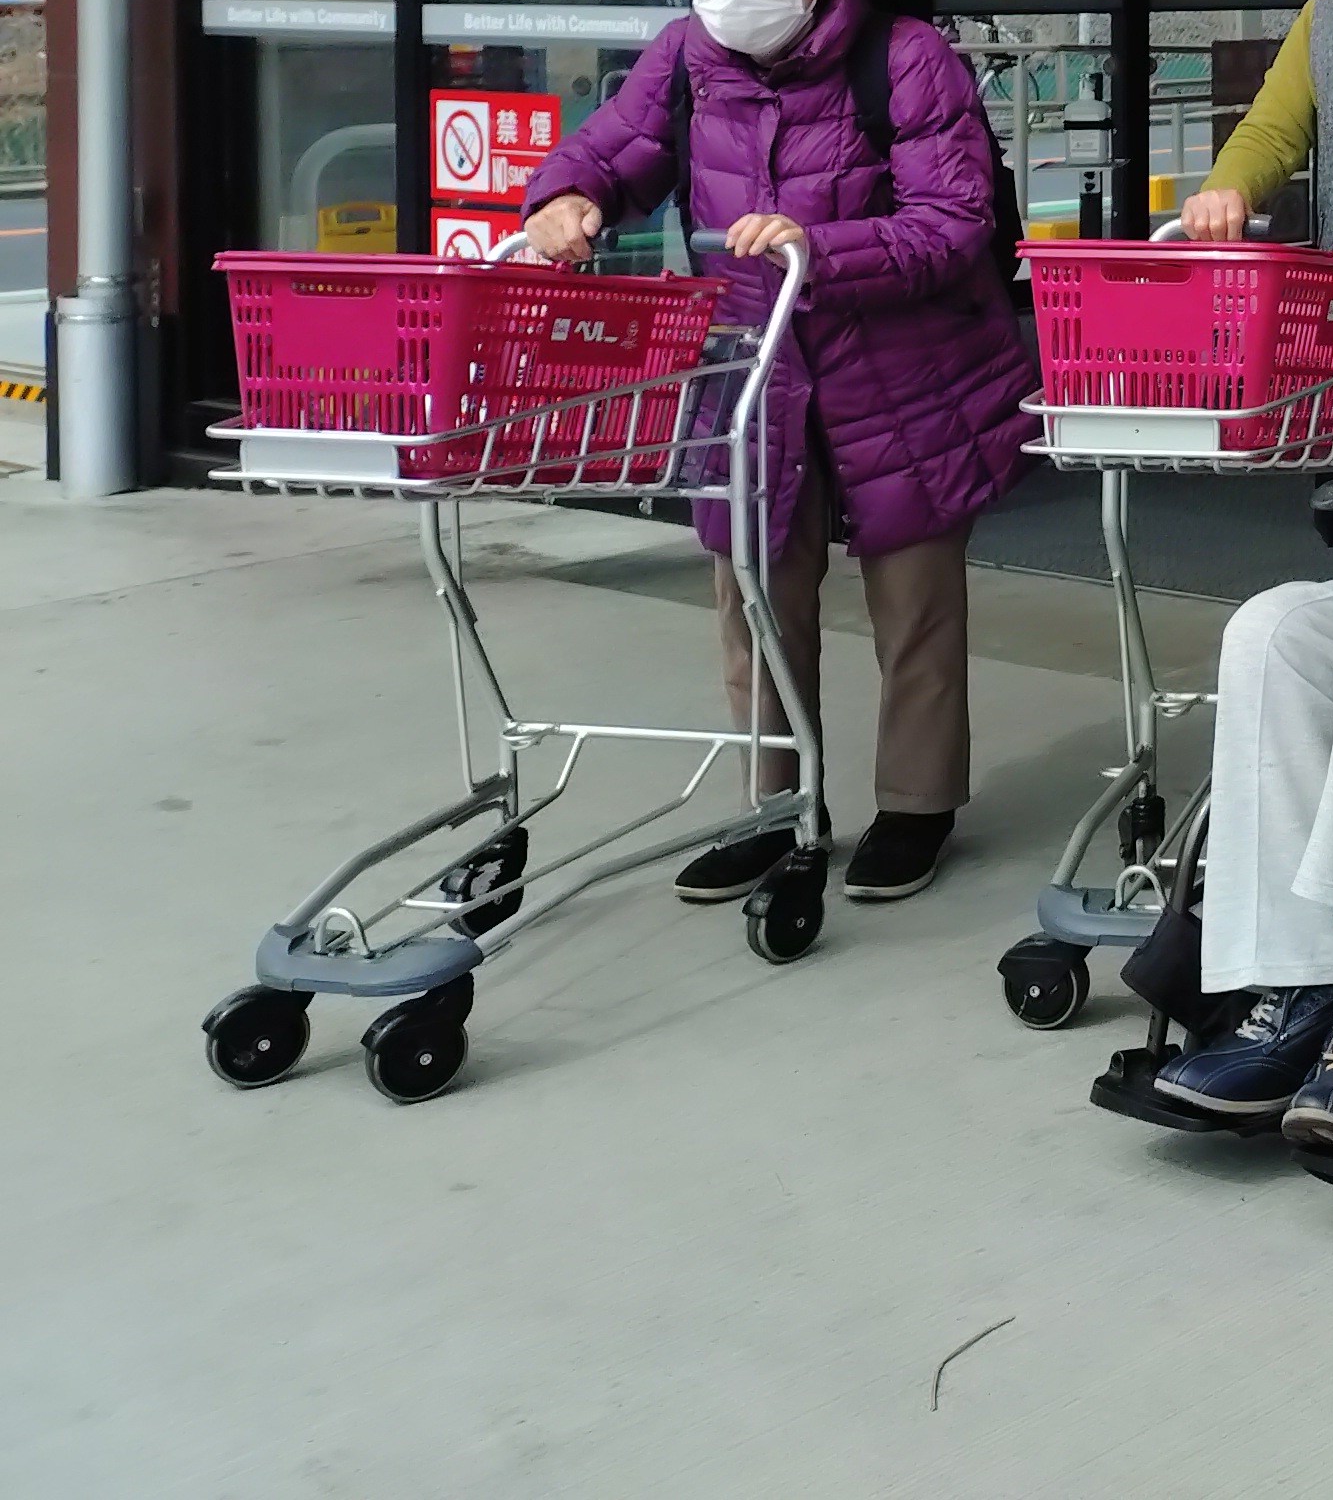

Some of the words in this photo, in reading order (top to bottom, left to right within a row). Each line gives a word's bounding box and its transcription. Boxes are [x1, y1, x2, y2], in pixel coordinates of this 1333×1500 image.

[464, 12, 505, 31] Better
[508, 13, 533, 32] Life
[536, 14, 567, 33] with
[568, 16, 649, 38] Community
[497, 109, 552, 147] 禁煙
[492, 156, 508, 194] NO
